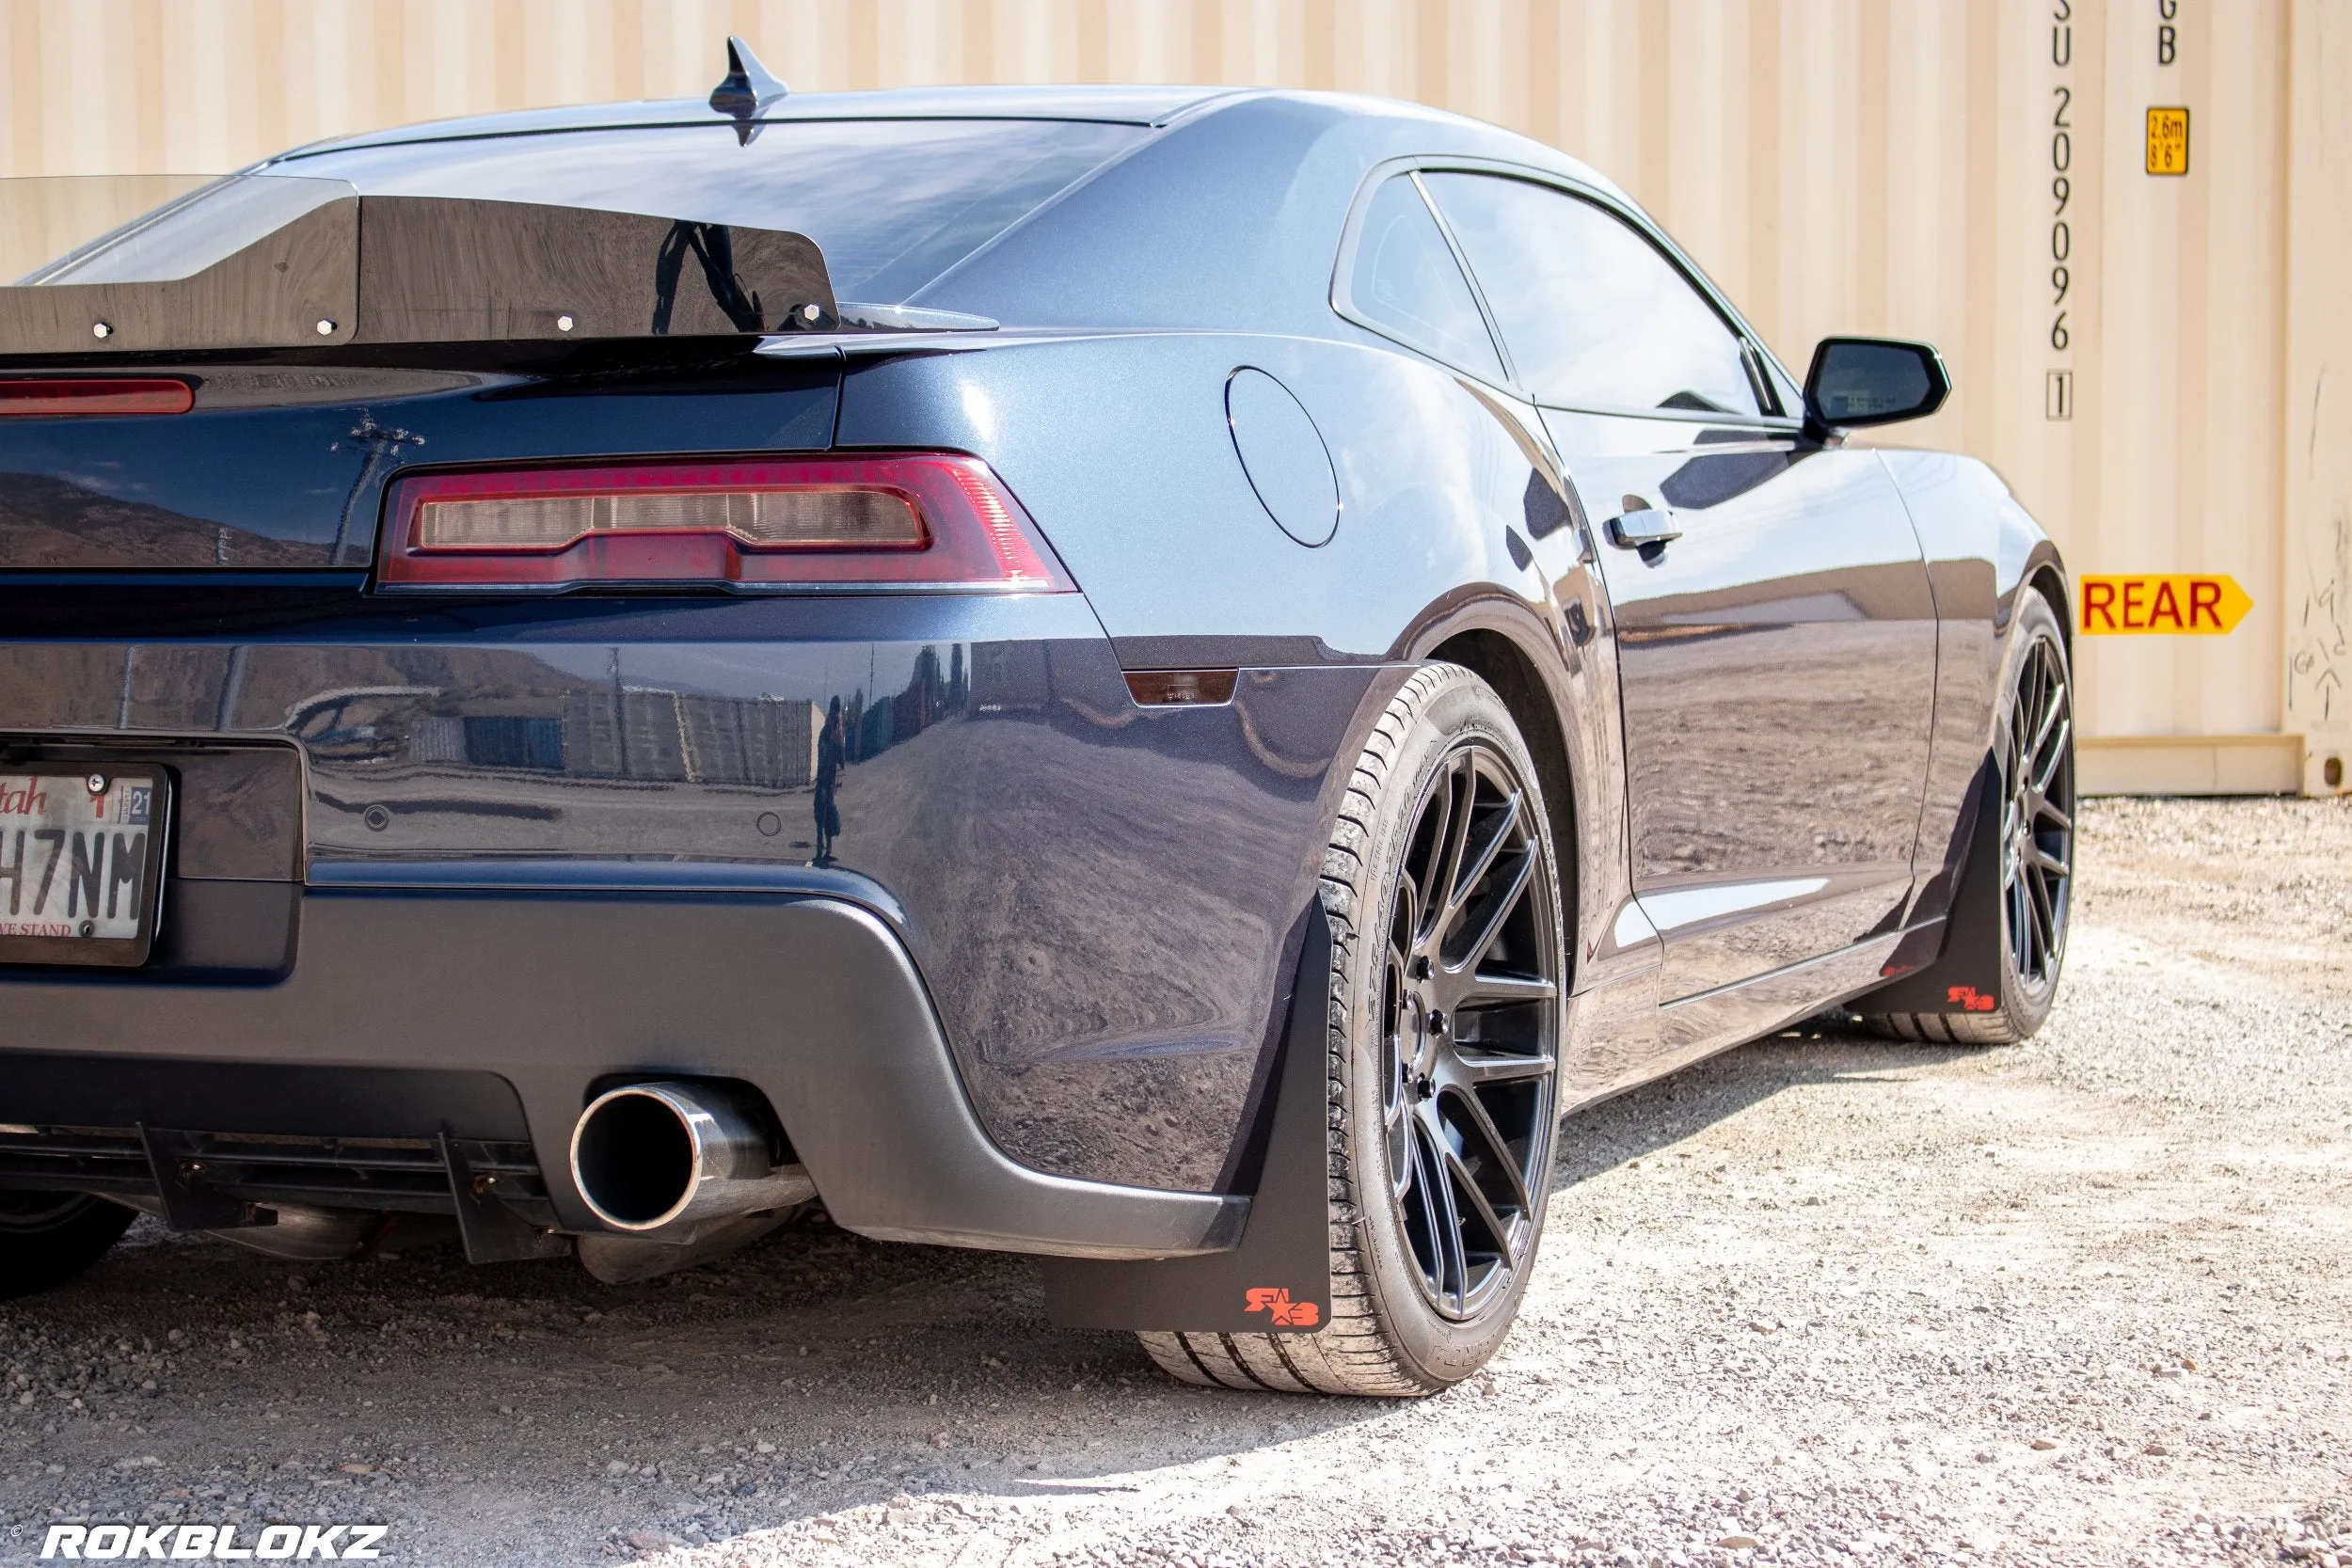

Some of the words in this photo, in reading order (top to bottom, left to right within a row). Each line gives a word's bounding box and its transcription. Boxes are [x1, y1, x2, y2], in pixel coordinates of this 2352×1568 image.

[2051, 87, 2072, 351] 209096
[2083, 581, 2223, 629] REAR
[21, 924, 72, 937] STAND
